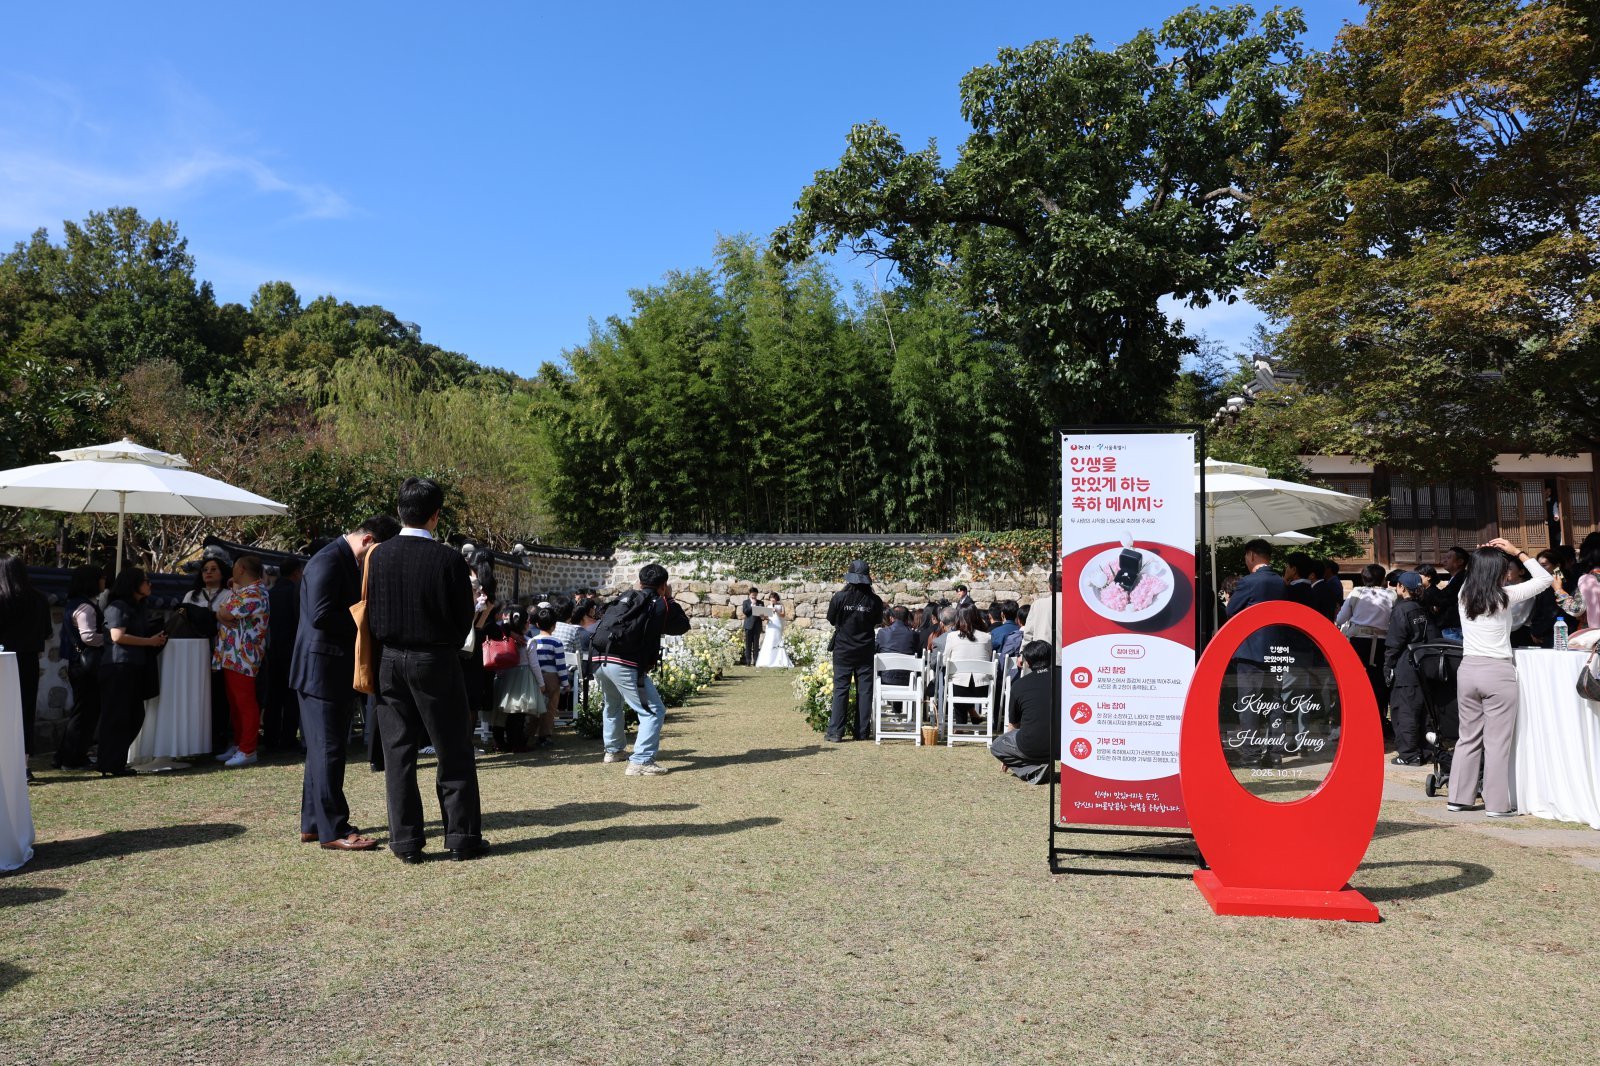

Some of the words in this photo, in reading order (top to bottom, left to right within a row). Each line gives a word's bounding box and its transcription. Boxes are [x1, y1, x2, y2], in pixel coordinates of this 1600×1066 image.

[1070, 456, 1117, 473] 인생을
[1071, 477, 1117, 493] 맛있게
[1120, 477, 1151, 493] 하는
[1071, 497, 1102, 512] 축하
[1105, 496, 1151, 512] 메시지
[1116, 648, 1128, 656] 참여
[1128, 648, 1140, 656] 안내
[1270, 646, 1290, 654] 인생이
[1263, 655, 1296, 663] 맛있어지는
[1097, 666, 1111, 674] 사진
[1112, 666, 1126, 675] 촬영
[1270, 665, 1290, 673] 결혼식
[1097, 702, 1111, 710] 나눔
[1111, 702, 1126, 710] 참여
[1233, 693, 1280, 716] Kipyo
[1282, 694, 1321, 713] Kim
[1271, 718, 1282, 728] &
[1097, 737, 1111, 745] 기부
[1111, 737, 1126, 746] 연계
[1228, 729, 1286, 748] Haneul
[1284, 730, 1326, 752] Jung
[1094, 790, 1112, 799] 인생이
[1113, 791, 1144, 800] 맛있어지는
[1145, 792, 1160, 801] 순간,
[1073, 800, 1094, 809] 당신의
[1129, 802, 1146, 812] 행복을
[1149, 802, 1181, 814] 응원합니다.
